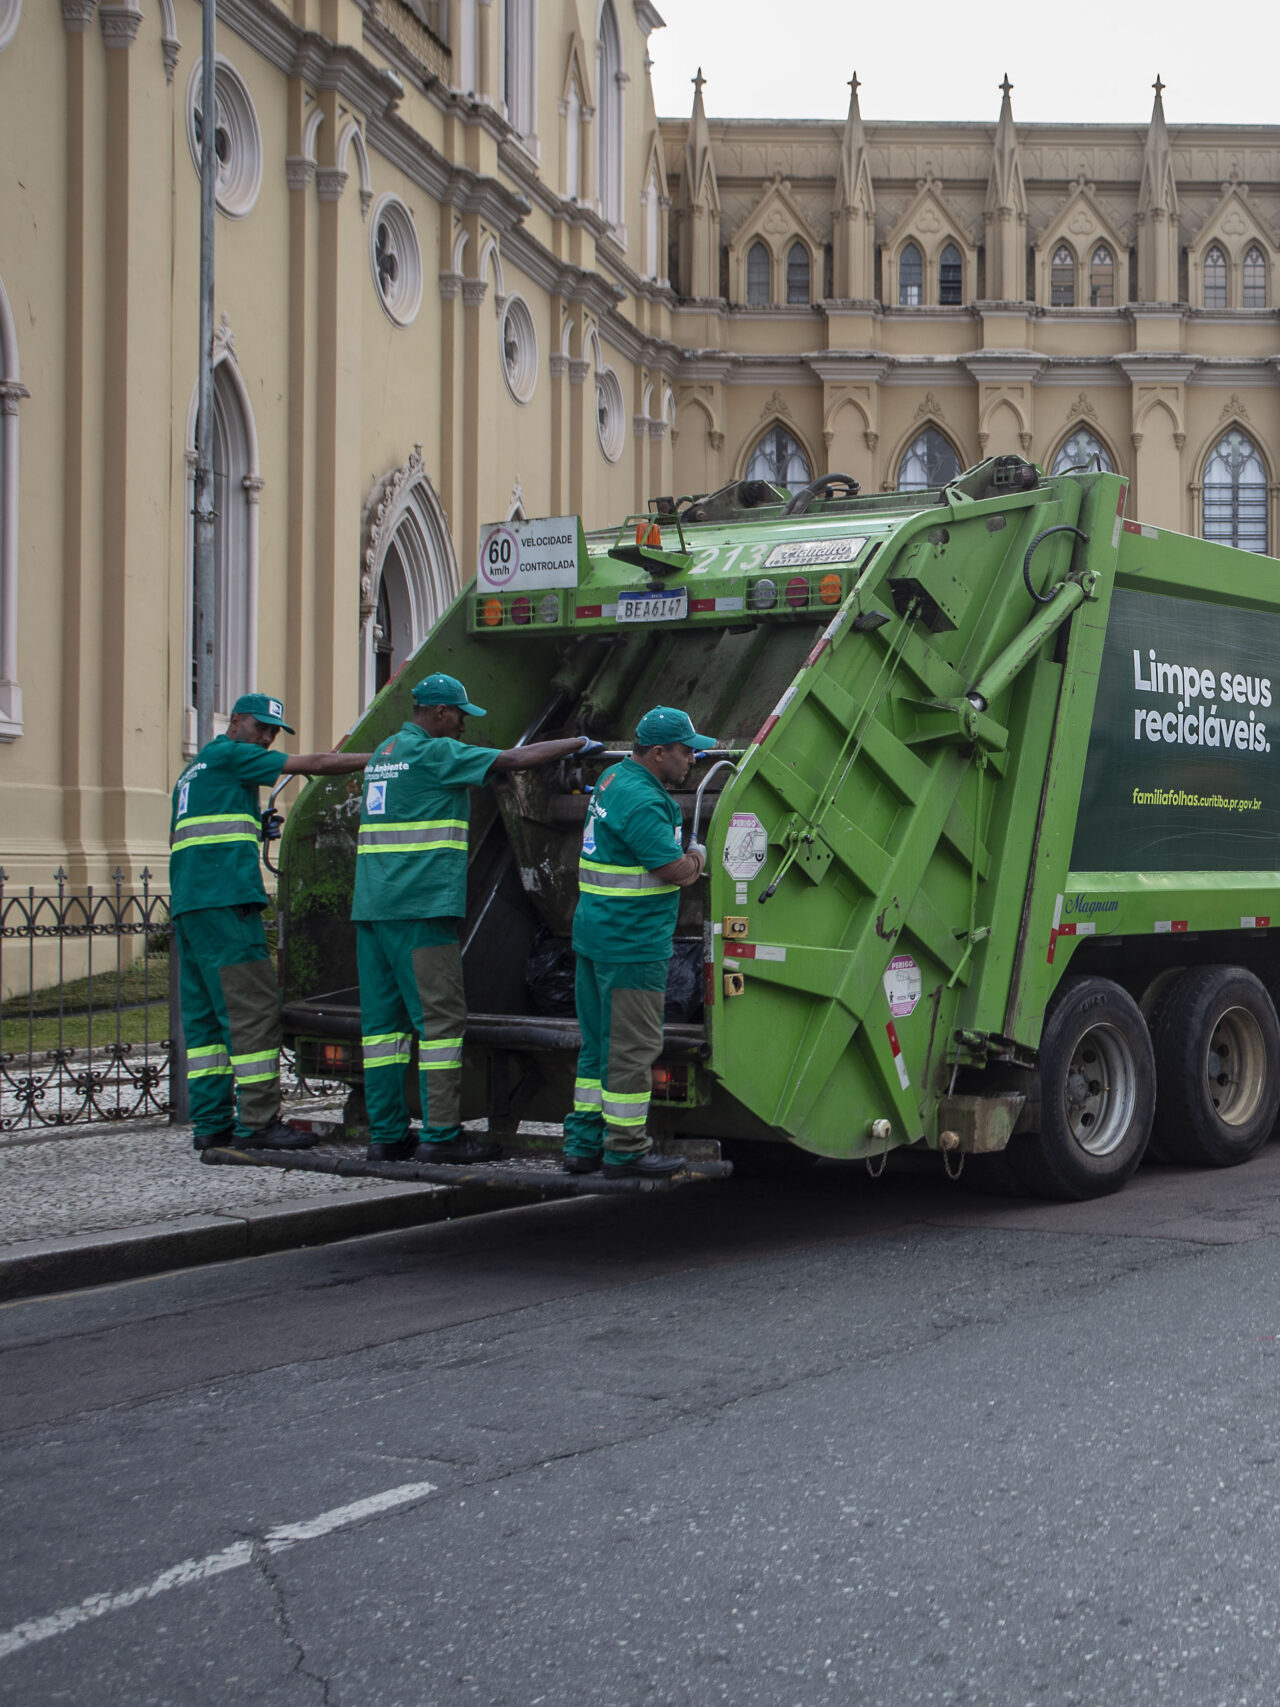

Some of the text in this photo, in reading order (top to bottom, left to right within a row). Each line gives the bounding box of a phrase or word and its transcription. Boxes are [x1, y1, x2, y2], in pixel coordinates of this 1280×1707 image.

[521, 535, 573, 547] VELOCIDADE
[488, 538, 511, 565] 60
[687, 543, 769, 575] 213
[489, 566, 510, 576] km/h
[519, 560, 575, 572] CONTROLADA
[1133, 648, 1272, 708] Limpe seus
[1134, 701, 1271, 753] recicláveis.
[374, 761, 410, 773] Ambiente
[1132, 787, 1262, 812] familiafolhas.curitiba.pr.gov.br
[732, 818, 757, 828] PERIGO
[1064, 893, 1119, 918] Magnum
[891, 960, 914, 969] PERIGO
